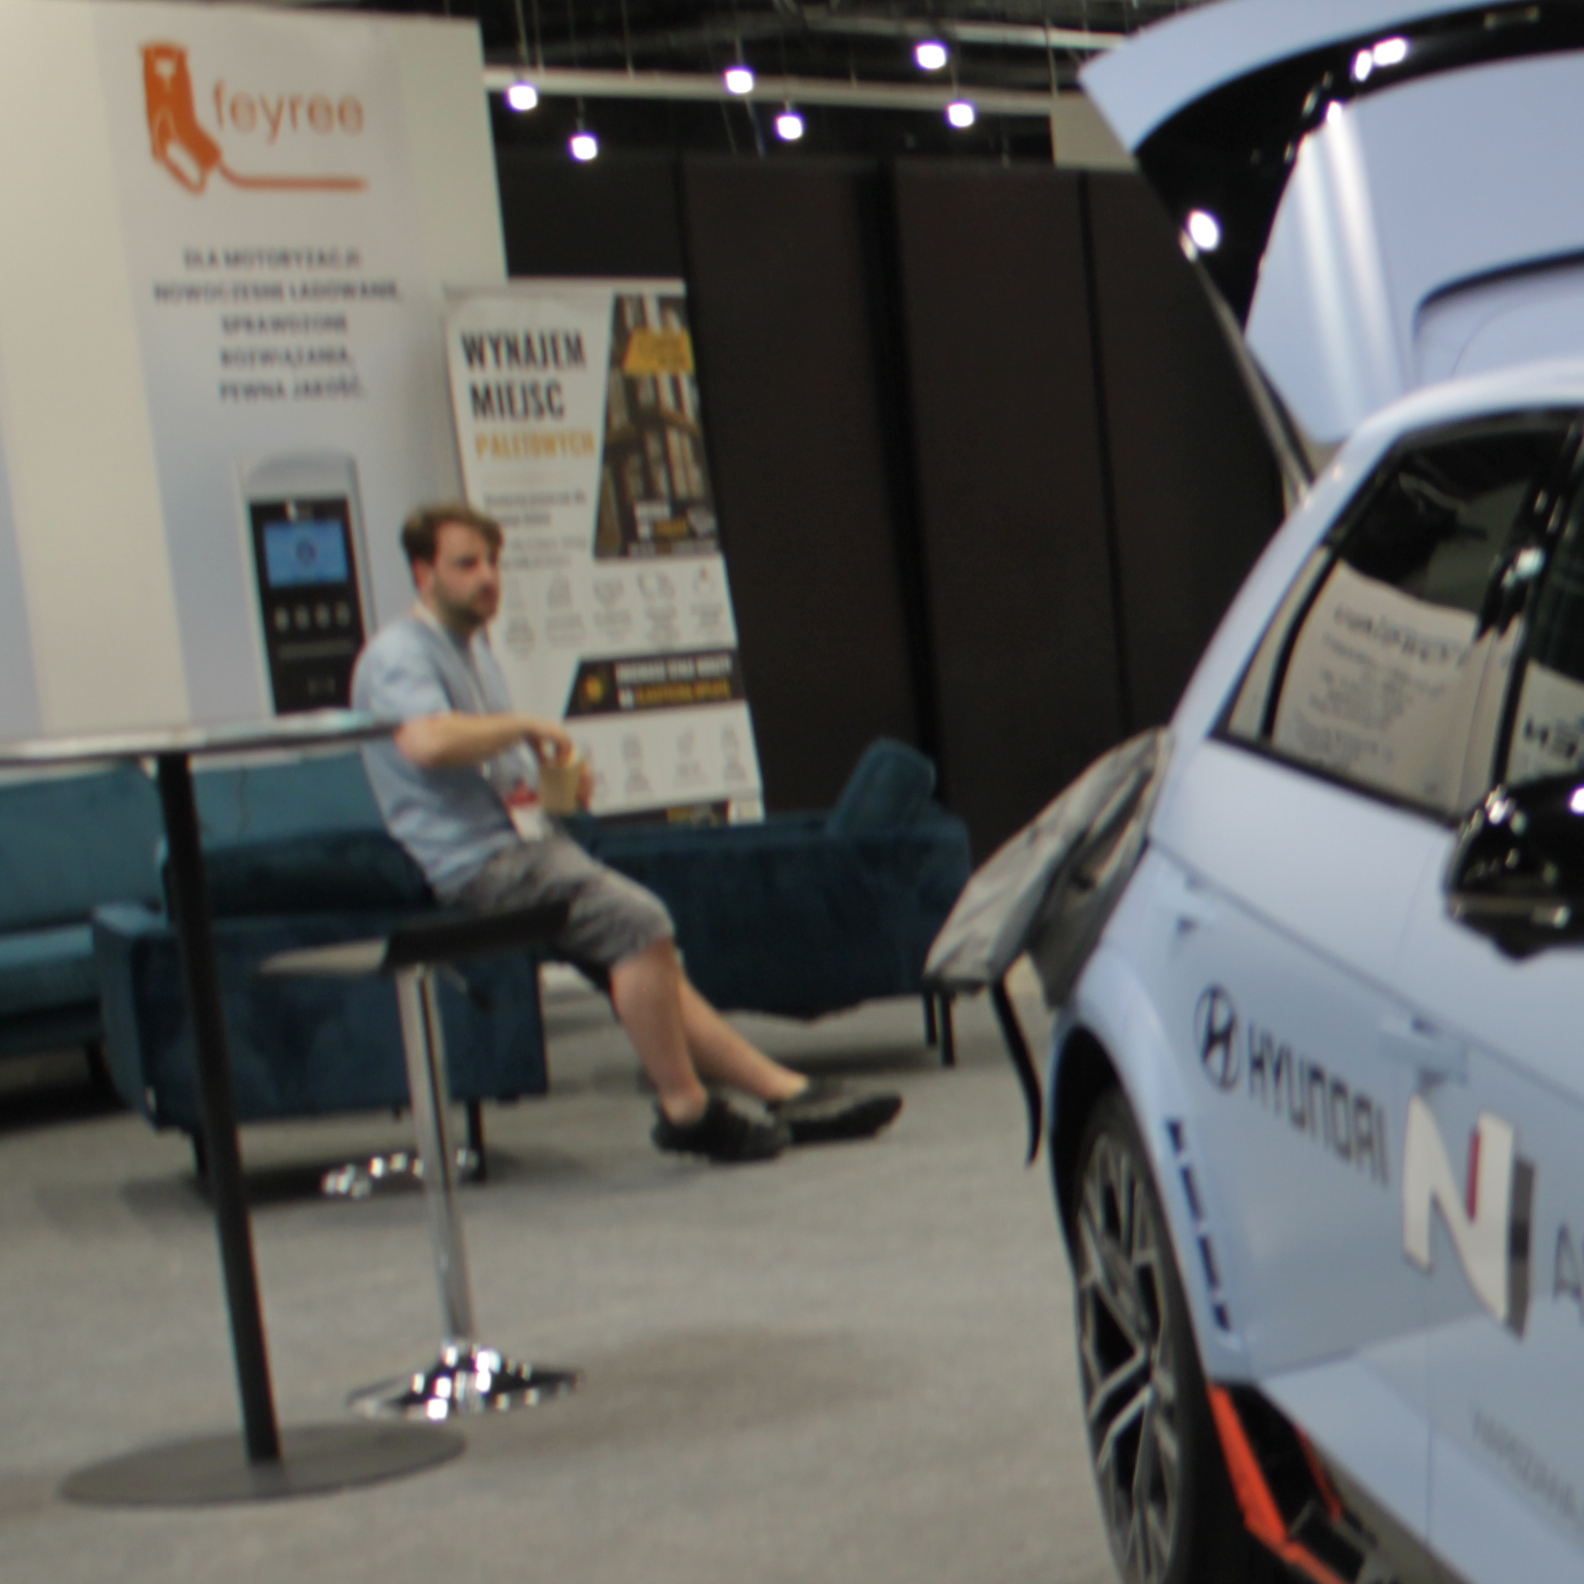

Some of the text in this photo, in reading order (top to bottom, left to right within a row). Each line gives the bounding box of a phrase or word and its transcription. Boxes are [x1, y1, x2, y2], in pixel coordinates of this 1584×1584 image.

[212, 79, 366, 146] feyree
[460, 327, 588, 372] WYNAJEM
[470, 379, 566, 421] MIEJSC
[1247, 1023, 1389, 1188] HYUNDAI
